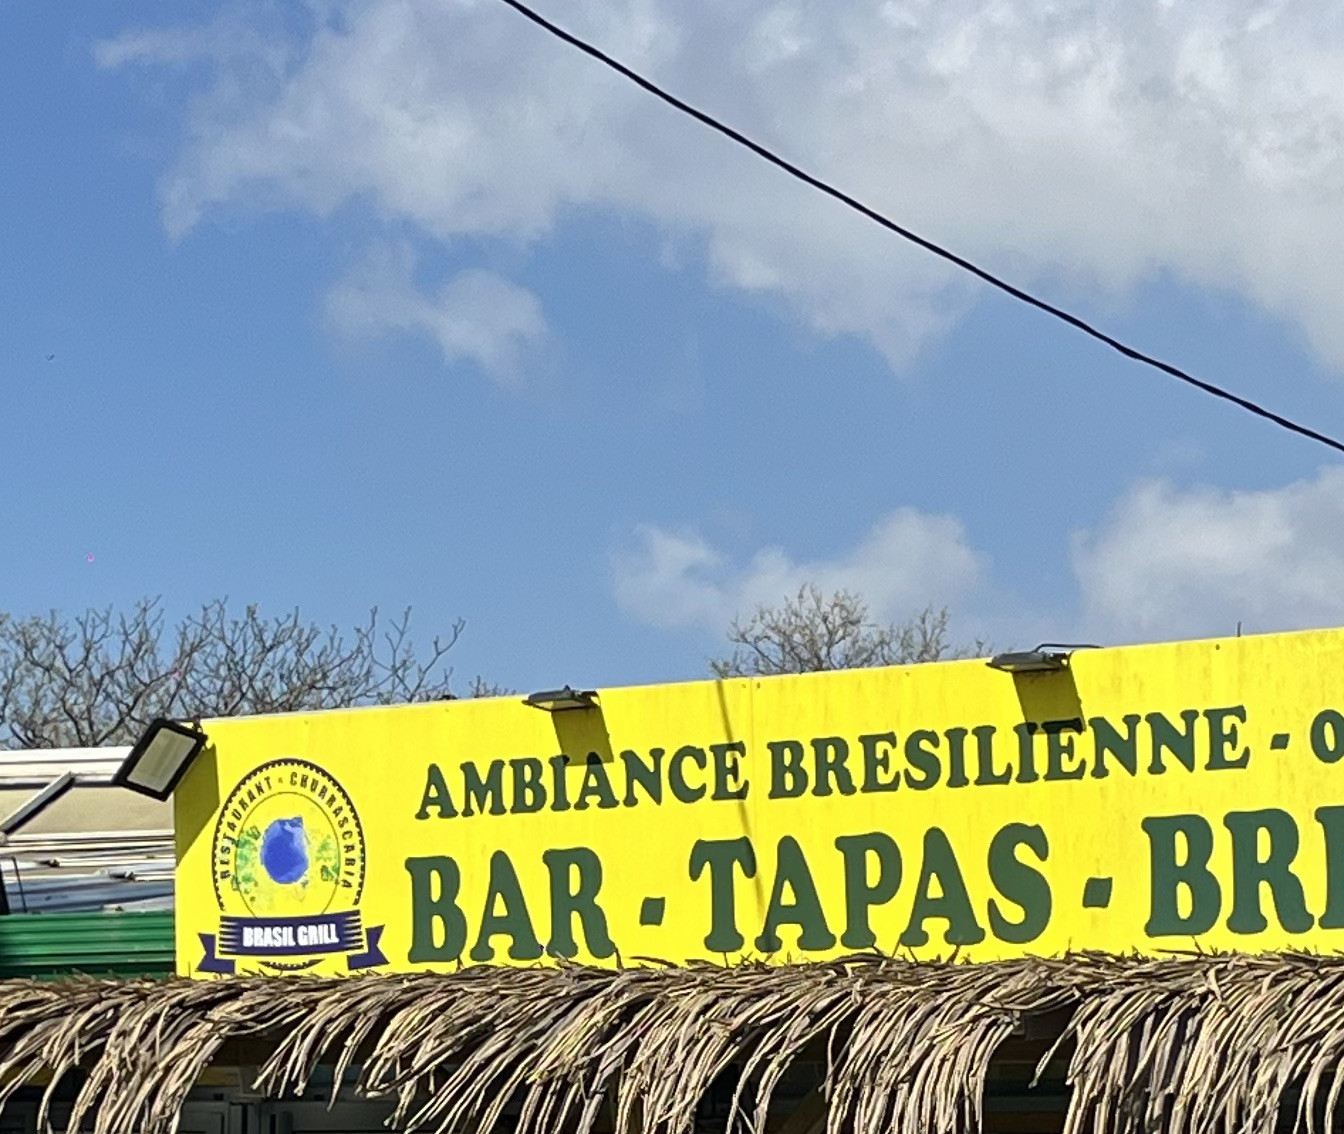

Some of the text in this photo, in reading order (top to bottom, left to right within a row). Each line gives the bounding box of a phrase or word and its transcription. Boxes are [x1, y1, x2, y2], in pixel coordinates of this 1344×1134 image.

[414, 741, 750, 821] AMBIANCE
[766, 704, 1252, 800] BRESILIENNE
[220, 772, 357, 889] RESTAURANT CHURRASCARIA
[242, 923, 339, 948] BRASIL GRILL
[405, 846, 618, 963] BAR
[688, 822, 1052, 953] TAPAS
